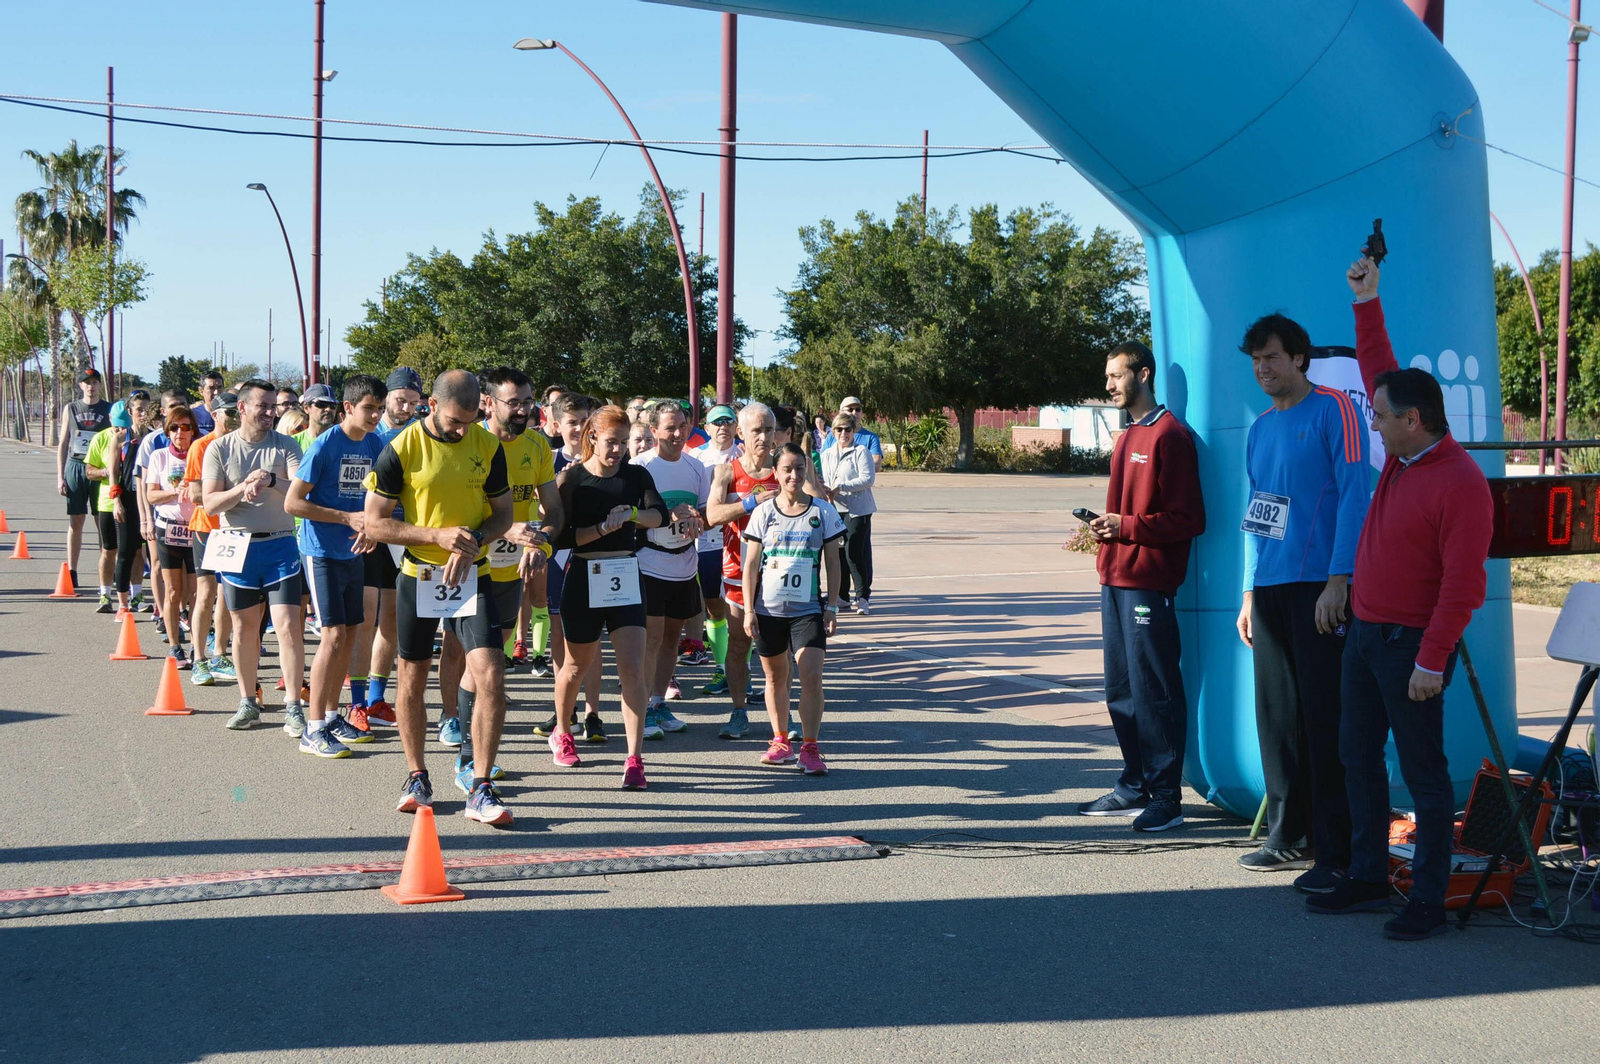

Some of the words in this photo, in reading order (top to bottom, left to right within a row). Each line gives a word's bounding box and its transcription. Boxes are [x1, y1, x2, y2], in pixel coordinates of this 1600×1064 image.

[343, 466, 366, 481] 4850
[1248, 501, 1281, 524] 4982
[1547, 486, 1600, 545] 0:
[216, 544, 236, 558] 25
[494, 538, 518, 554] 28
[610, 576, 621, 592] 3
[780, 573, 802, 588] 10
[434, 584, 462, 602] 32
